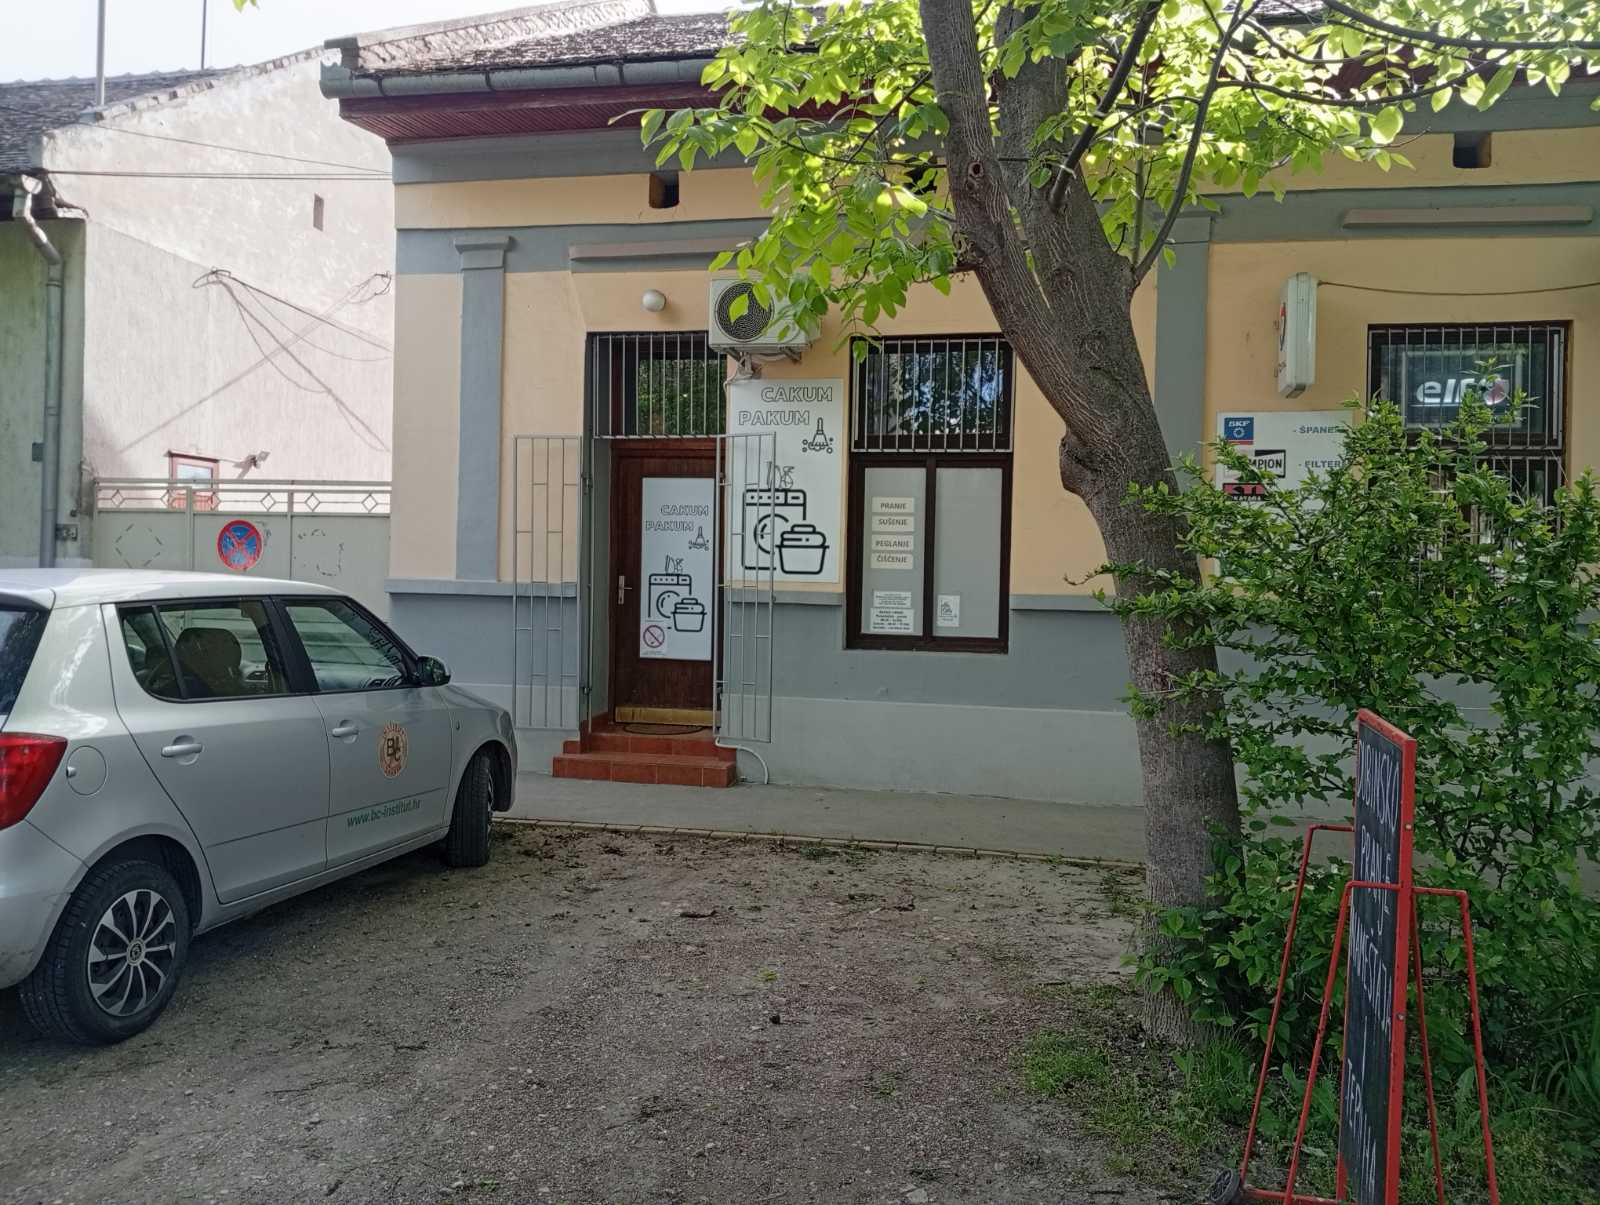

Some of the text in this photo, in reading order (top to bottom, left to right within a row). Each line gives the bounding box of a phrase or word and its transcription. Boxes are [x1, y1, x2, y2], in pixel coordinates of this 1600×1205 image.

[761, 386, 833, 403] CAKUM
[738, 410, 810, 426] PAKUM
[1228, 420, 1251, 428] SKF
[660, 504, 709, 517] CAKUM
[880, 502, 908, 511] PRANJE
[645, 520, 694, 533] PAKUM
[878, 517, 908, 527] SUŠENJE
[875, 540, 910, 549] PEGLANJE
[1356, 738, 1400, 835] DUBINSKO
[346, 799, 421, 828] www.bc-institut.hr
